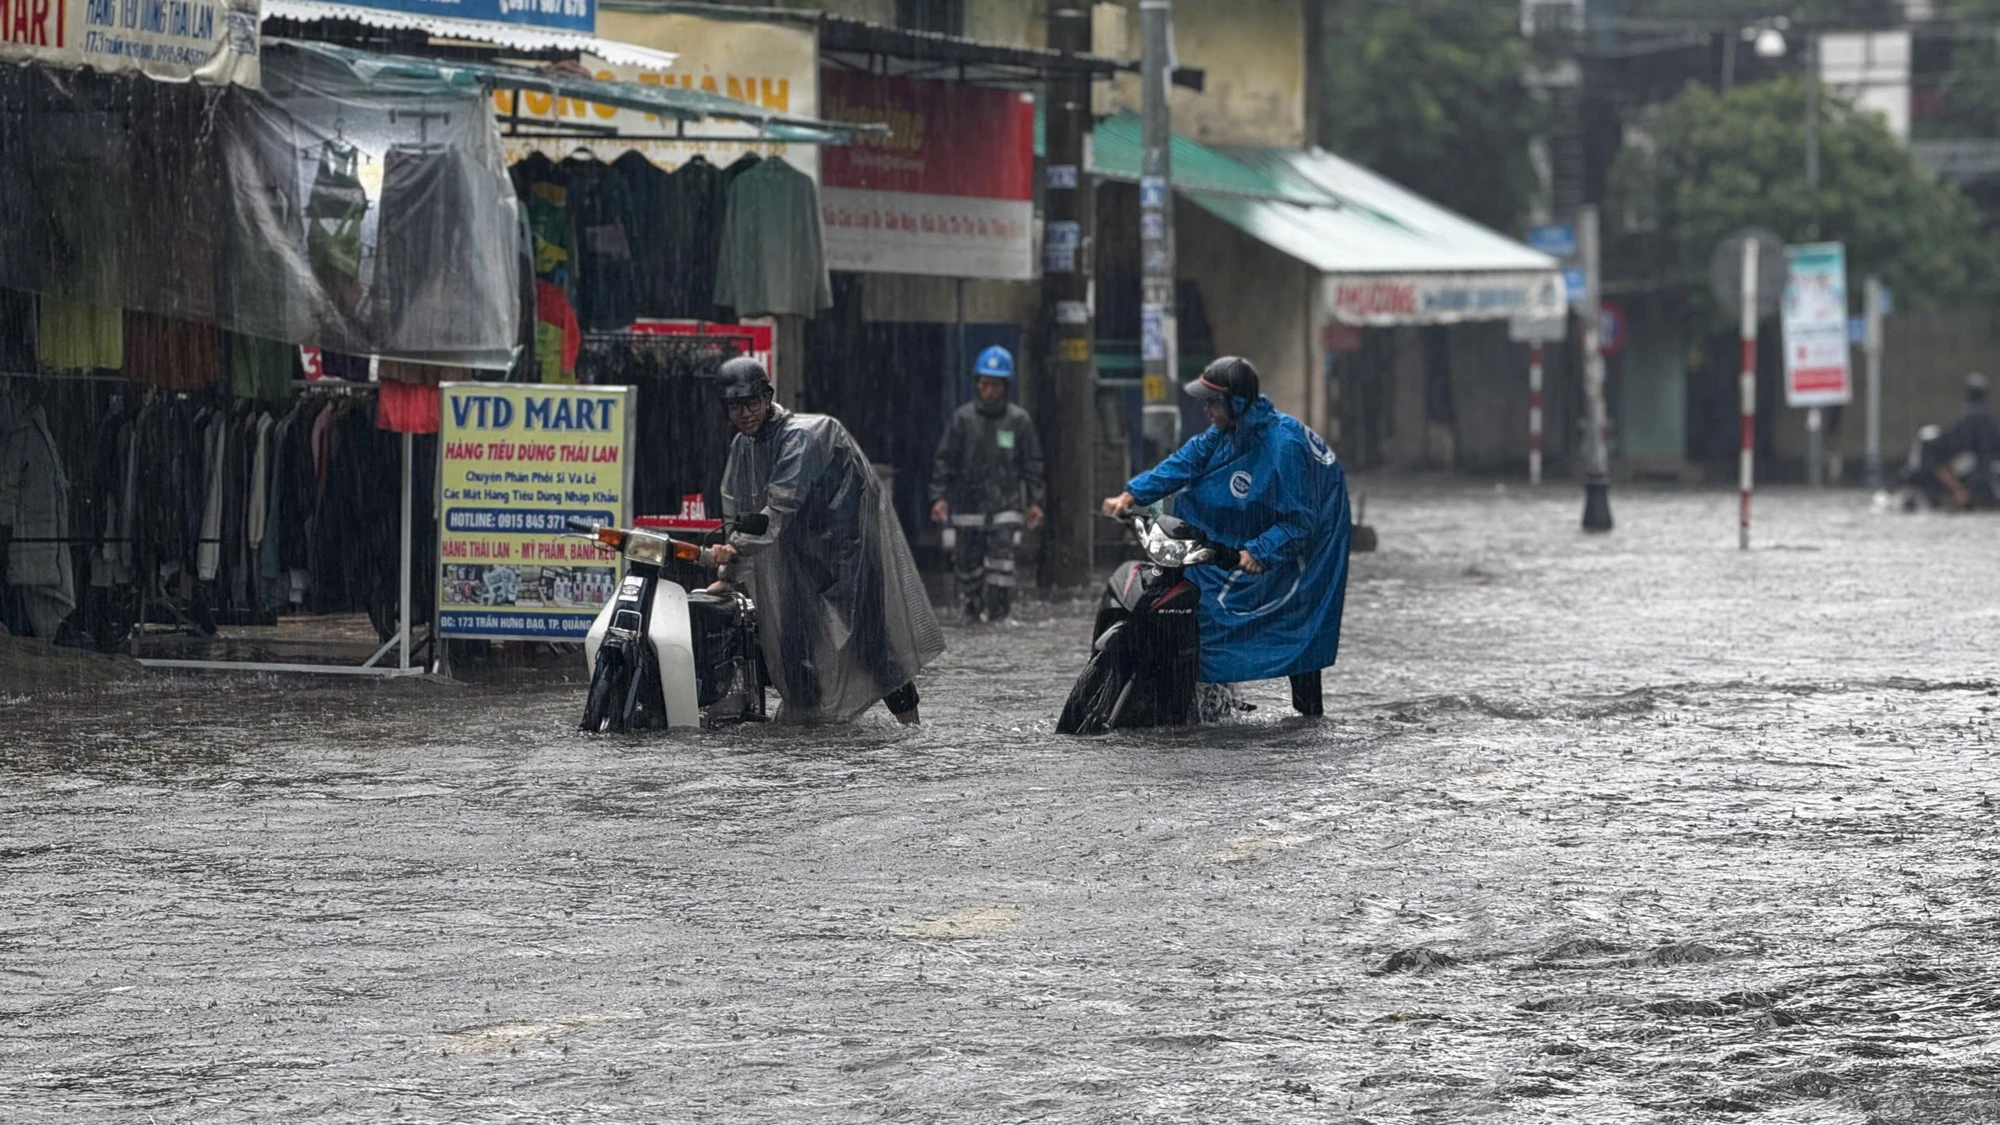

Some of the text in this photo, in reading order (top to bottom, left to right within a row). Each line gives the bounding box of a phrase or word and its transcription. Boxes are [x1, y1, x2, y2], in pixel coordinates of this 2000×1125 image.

[192, 3, 214, 40] LAN
[85, 30, 104, 52] 173
[451, 395, 617, 431] VTD MART
[445, 437, 618, 463] HÀNG TIÊU DÙNG THÁI LAN
[450, 512, 496, 528] HOTLINE:
[498, 513, 523, 529] 0915
[525, 513, 545, 529] 845
[547, 514, 565, 530] 371
[442, 537, 467, 557] HÀNG
[470, 537, 490, 558] THÁI
[492, 541, 510, 559] LAN
[458, 616, 474, 628] 173
[475, 614, 498, 628] TRẦN
[500, 617, 524, 629] HƯNG
[549, 618, 560, 630] TP.
[562, 616, 593, 631] QUẢNG
